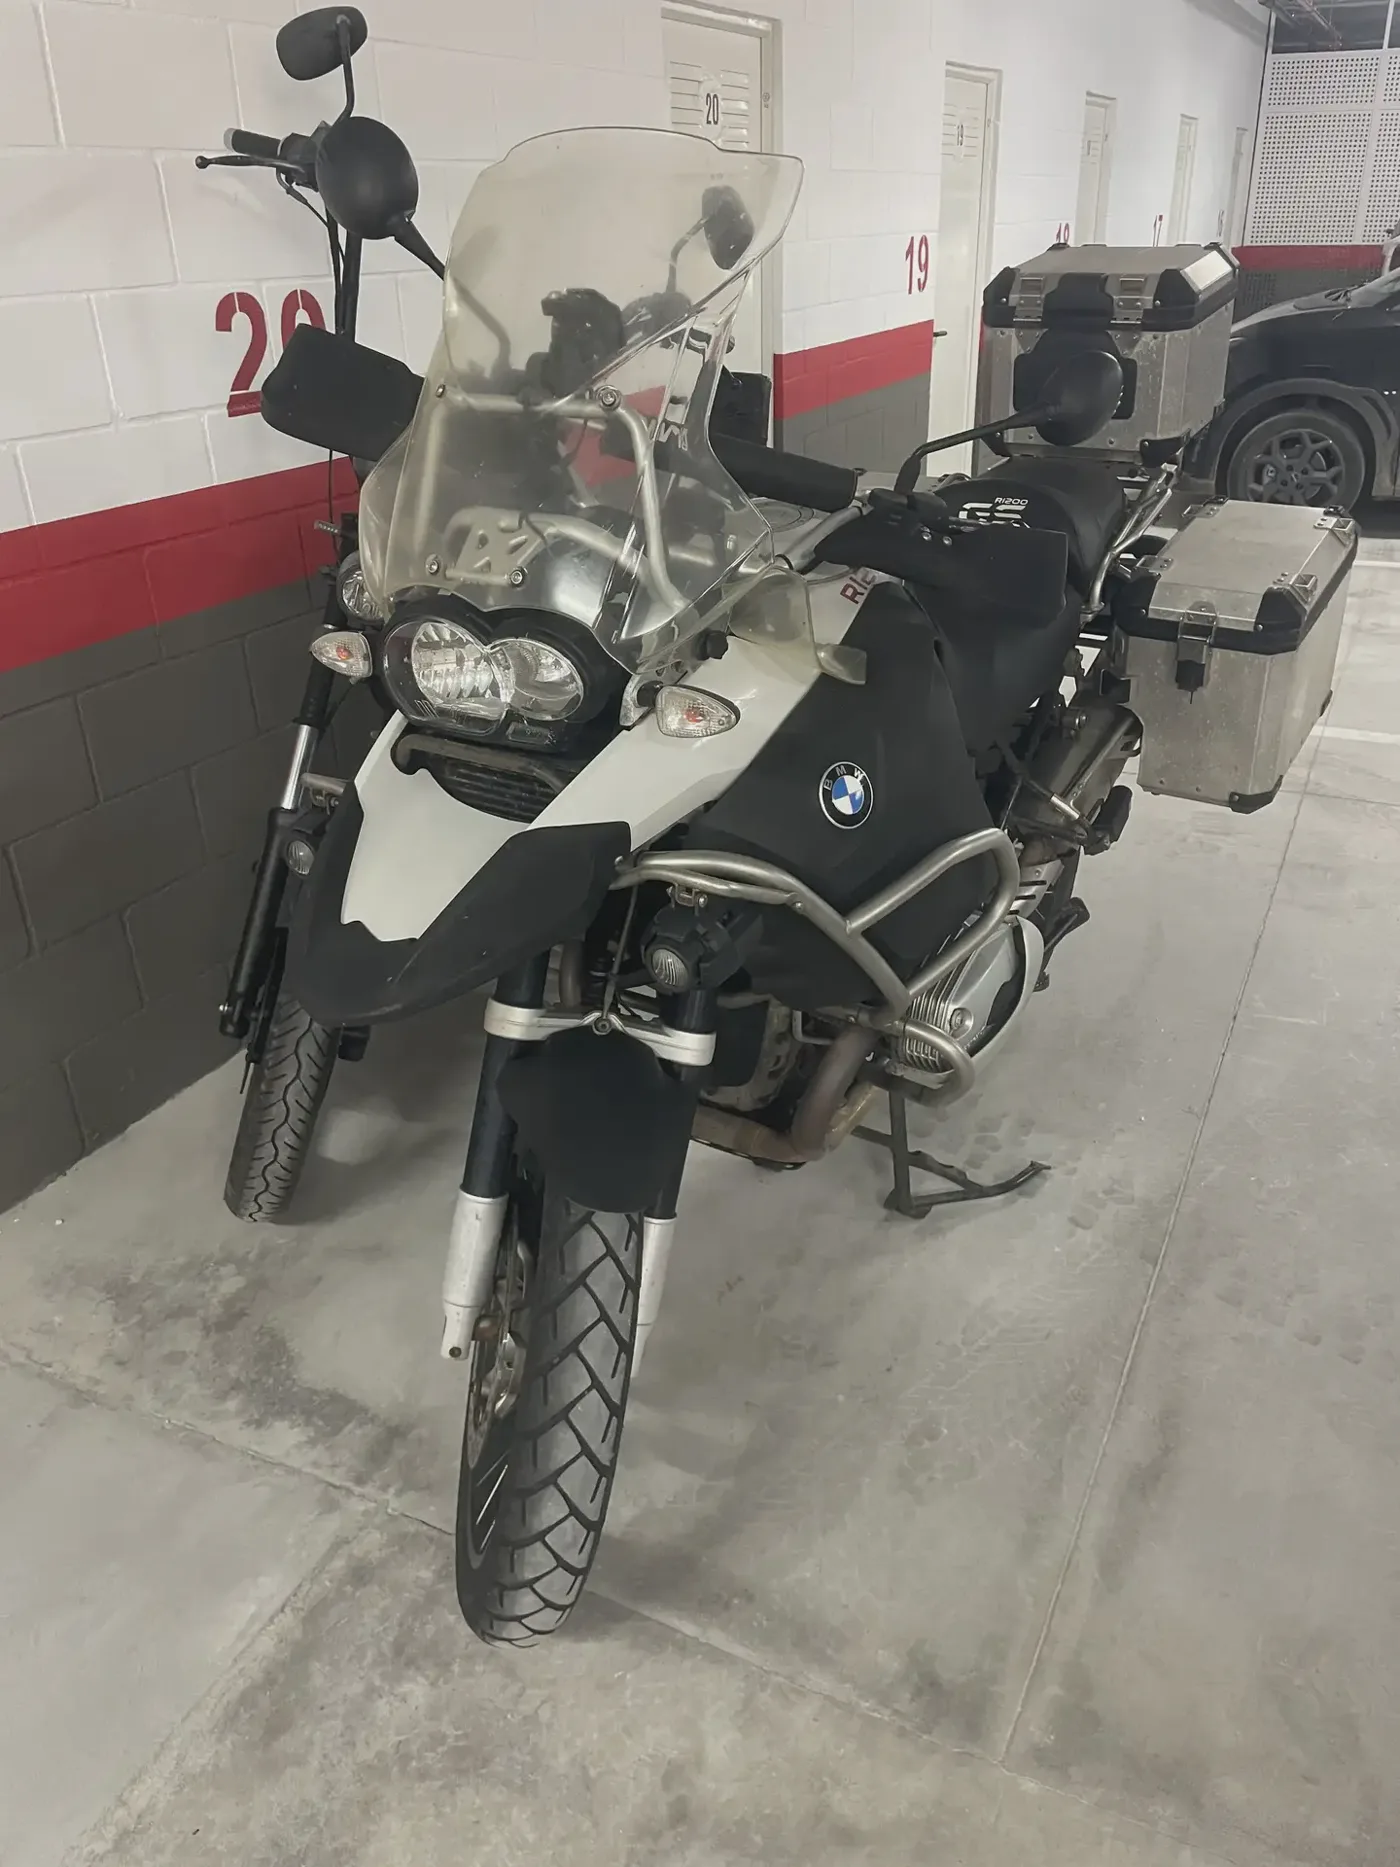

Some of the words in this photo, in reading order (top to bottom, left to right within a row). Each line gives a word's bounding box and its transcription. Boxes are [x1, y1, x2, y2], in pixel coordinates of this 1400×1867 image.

[706, 93, 719, 125] 20
[905, 235, 929, 295] 19
[823, 764, 866, 791] BMW
